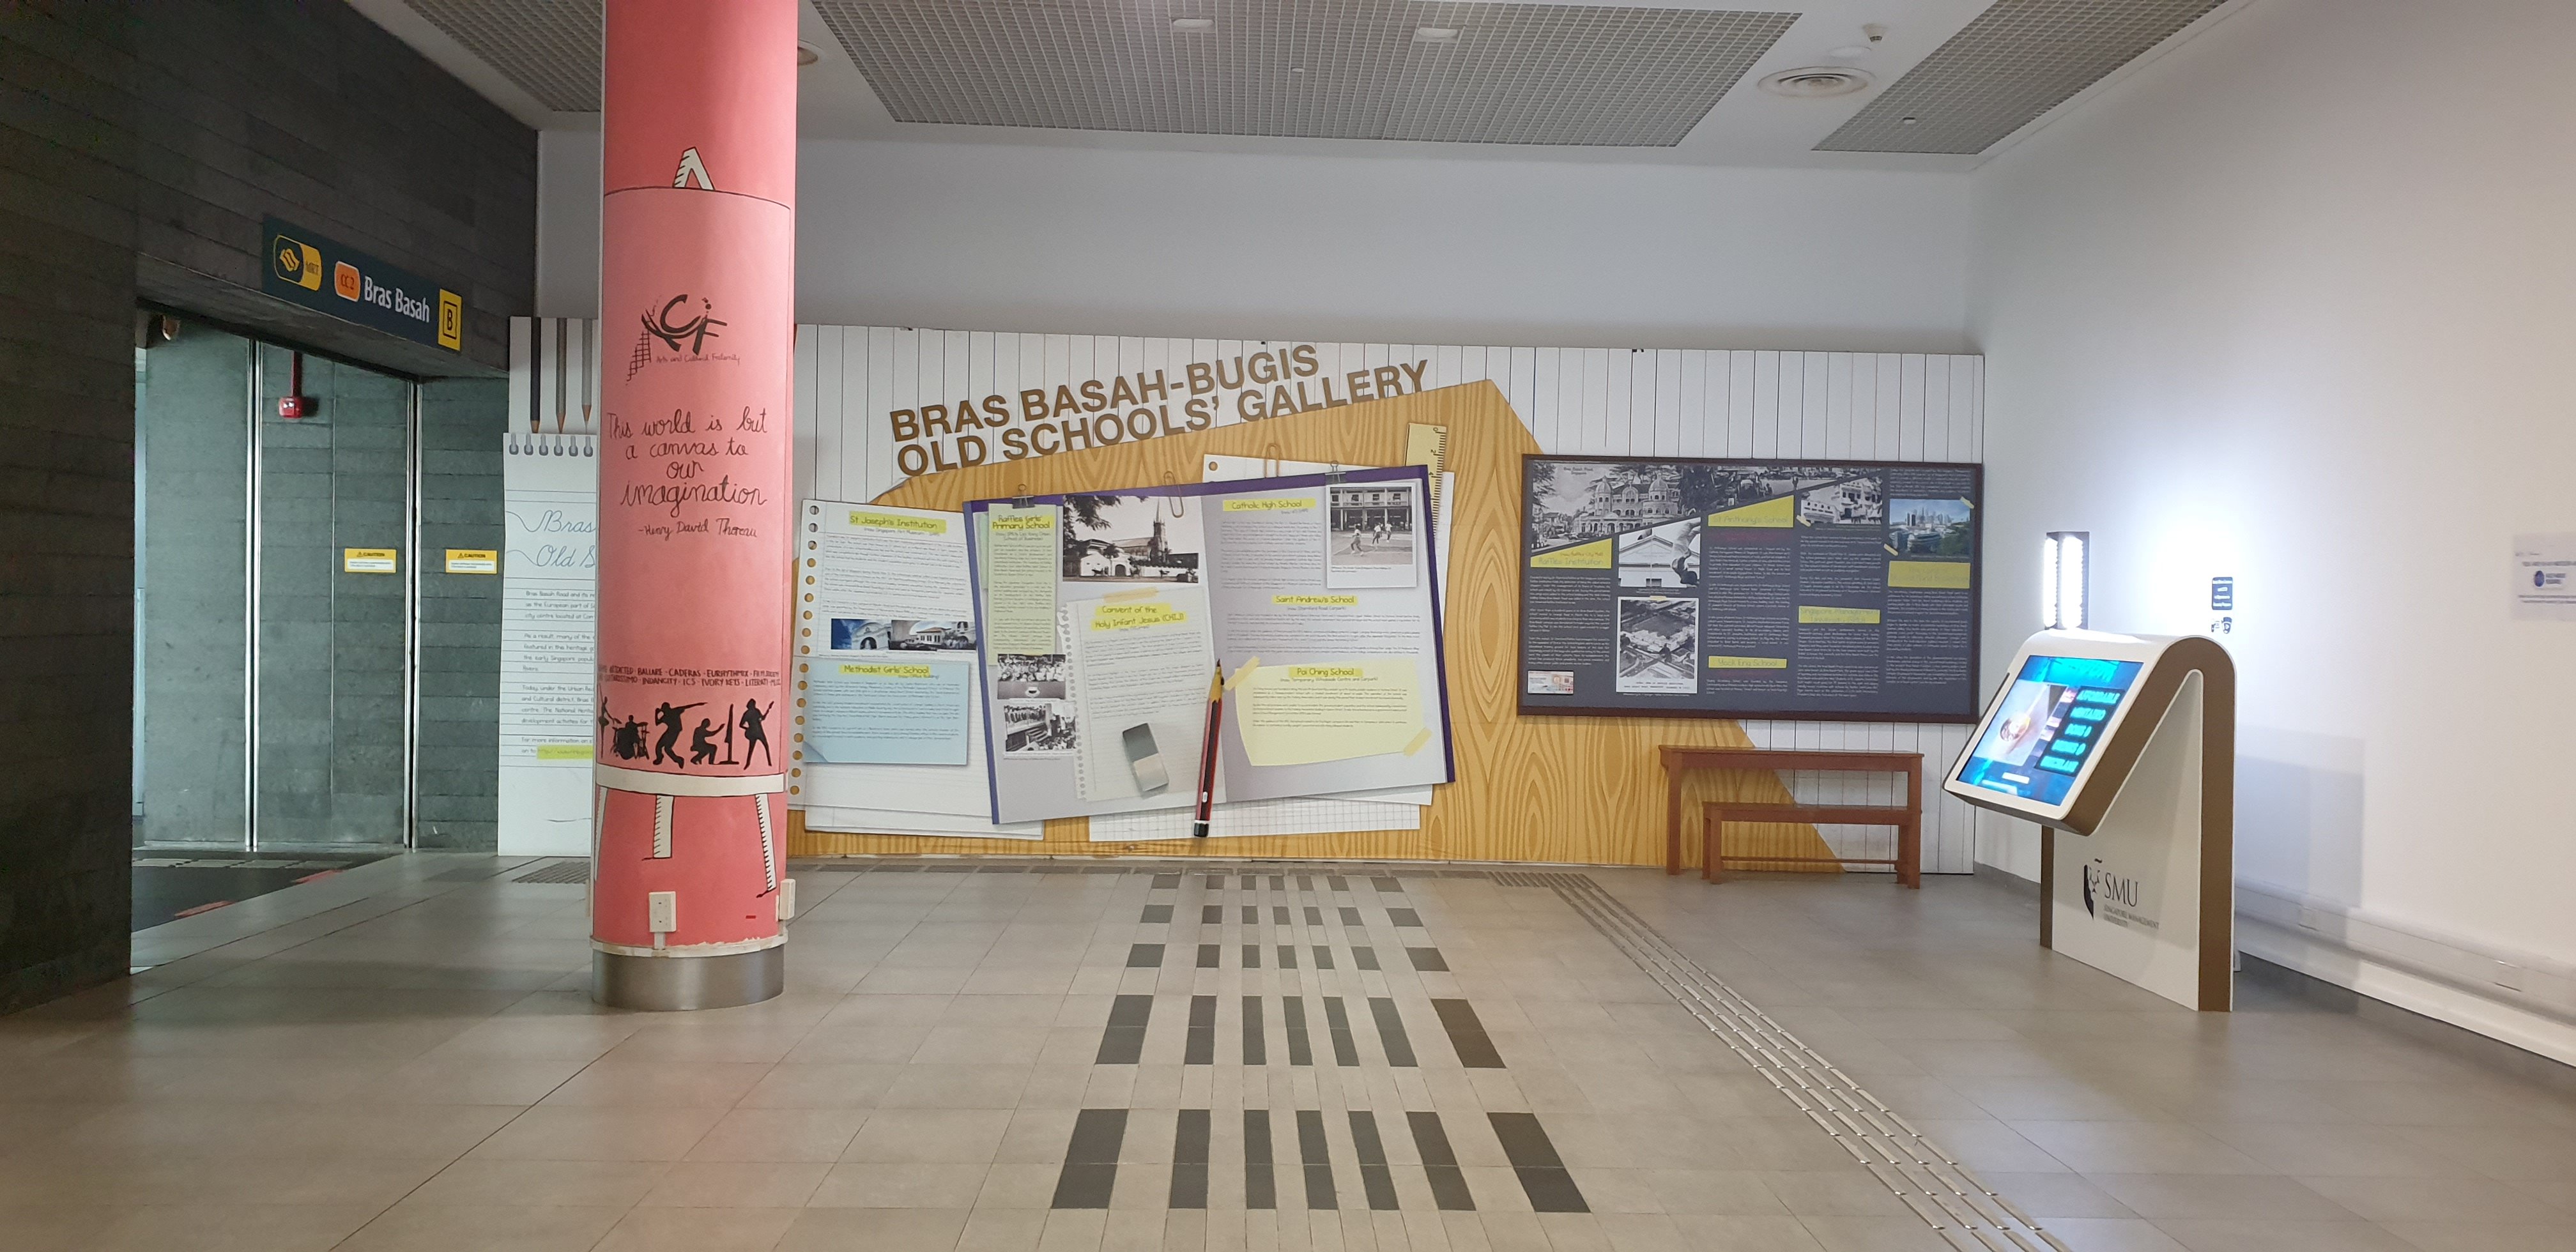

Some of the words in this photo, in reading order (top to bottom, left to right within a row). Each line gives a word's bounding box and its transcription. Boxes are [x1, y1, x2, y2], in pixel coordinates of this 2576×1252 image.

[340, 273, 355, 290] CC2
[364, 275, 392, 309] Bras
[394, 287, 430, 323] Basah
[447, 309, 453, 331] B
[889, 394, 1010, 442] BRAS
[1020, 344, 1319, 422] BASAH-BUGIS
[608, 413, 634, 439] This
[641, 408, 696, 436] world
[705, 415, 723, 431] is
[736, 406, 768, 433] but
[897, 435, 986, 477] OLD
[1237, 359, 1429, 422] GALLERY
[625, 445, 638, 460] a
[649, 442, 719, 458] canvas
[725, 437, 749, 456] to
[666, 460, 705, 479] our
[620, 475, 768, 518] imagination
[1232, 501, 1259, 510] Catholic
[1261, 501, 1276, 510] High
[543, 510, 596, 533] Bras
[676, 518, 709, 533] David
[716, 517, 758, 538] Thoreau
[861, 517, 894, 526] Joseph's
[897, 519, 938, 529] Institution
[992, 521, 1023, 531] Primary
[1025, 521, 1050, 530] School
[998, 514, 1023, 523] Raffles
[537, 544, 576, 567] Old
[579, 545, 595, 568] S
[1296, 595, 1329, 604] Andrew's
[1095, 620, 1111, 629] Holy
[1113, 618, 1136, 627] Infant
[668, 668, 701, 677] CADERAS
[844, 664, 881, 673] Methodist
[903, 666, 929, 675] School
[1309, 668, 1329, 678] Ching
[1330, 668, 1354, 676] School
[702, 678, 724, 687] IVORY
[2104, 873, 2138, 907] SMU
